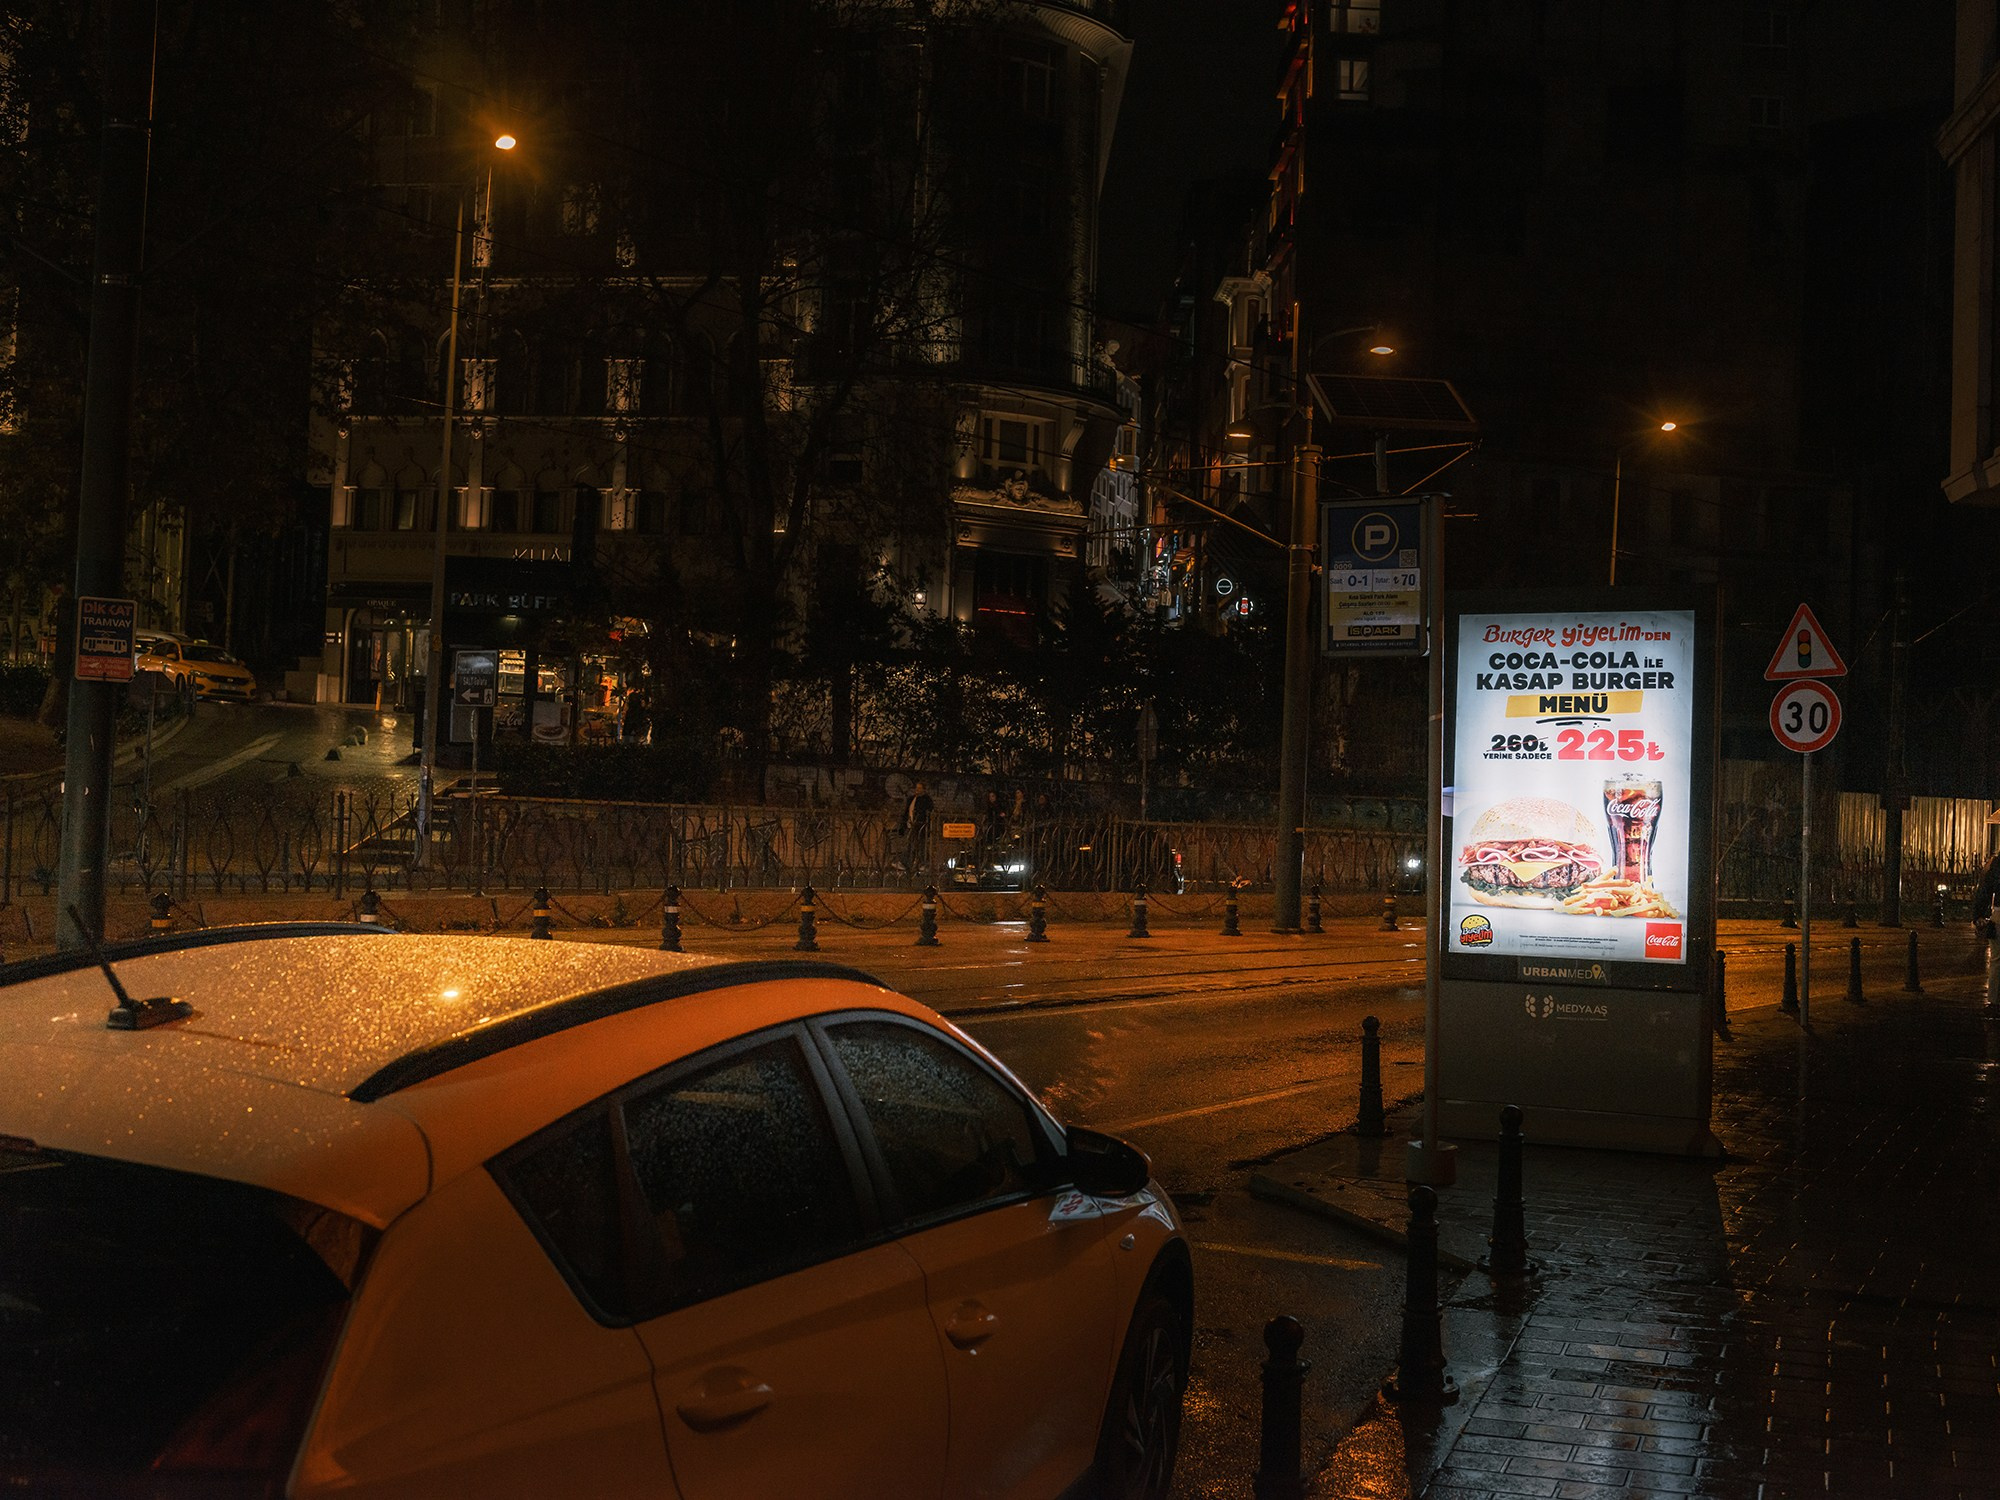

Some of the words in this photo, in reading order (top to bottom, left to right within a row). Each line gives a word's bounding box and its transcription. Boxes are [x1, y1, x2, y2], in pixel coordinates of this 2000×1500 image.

[1347, 574, 1369, 587] 0-1
[450, 591, 500, 608] PARK
[508, 592, 558, 609] BÜFE
[82, 616, 132, 628] TRAMVAY
[1488, 651, 1639, 669] COCA-COLA
[1643, 656, 1664, 669] İLE
[1476, 673, 1564, 690] KASAP
[1572, 671, 1675, 690] BURGER
[1538, 692, 1609, 713] MENÜ
[1784, 701, 1829, 734] 30
[1482, 752, 1513, 760] YERİNE
[1515, 752, 1553, 760] SADECE
